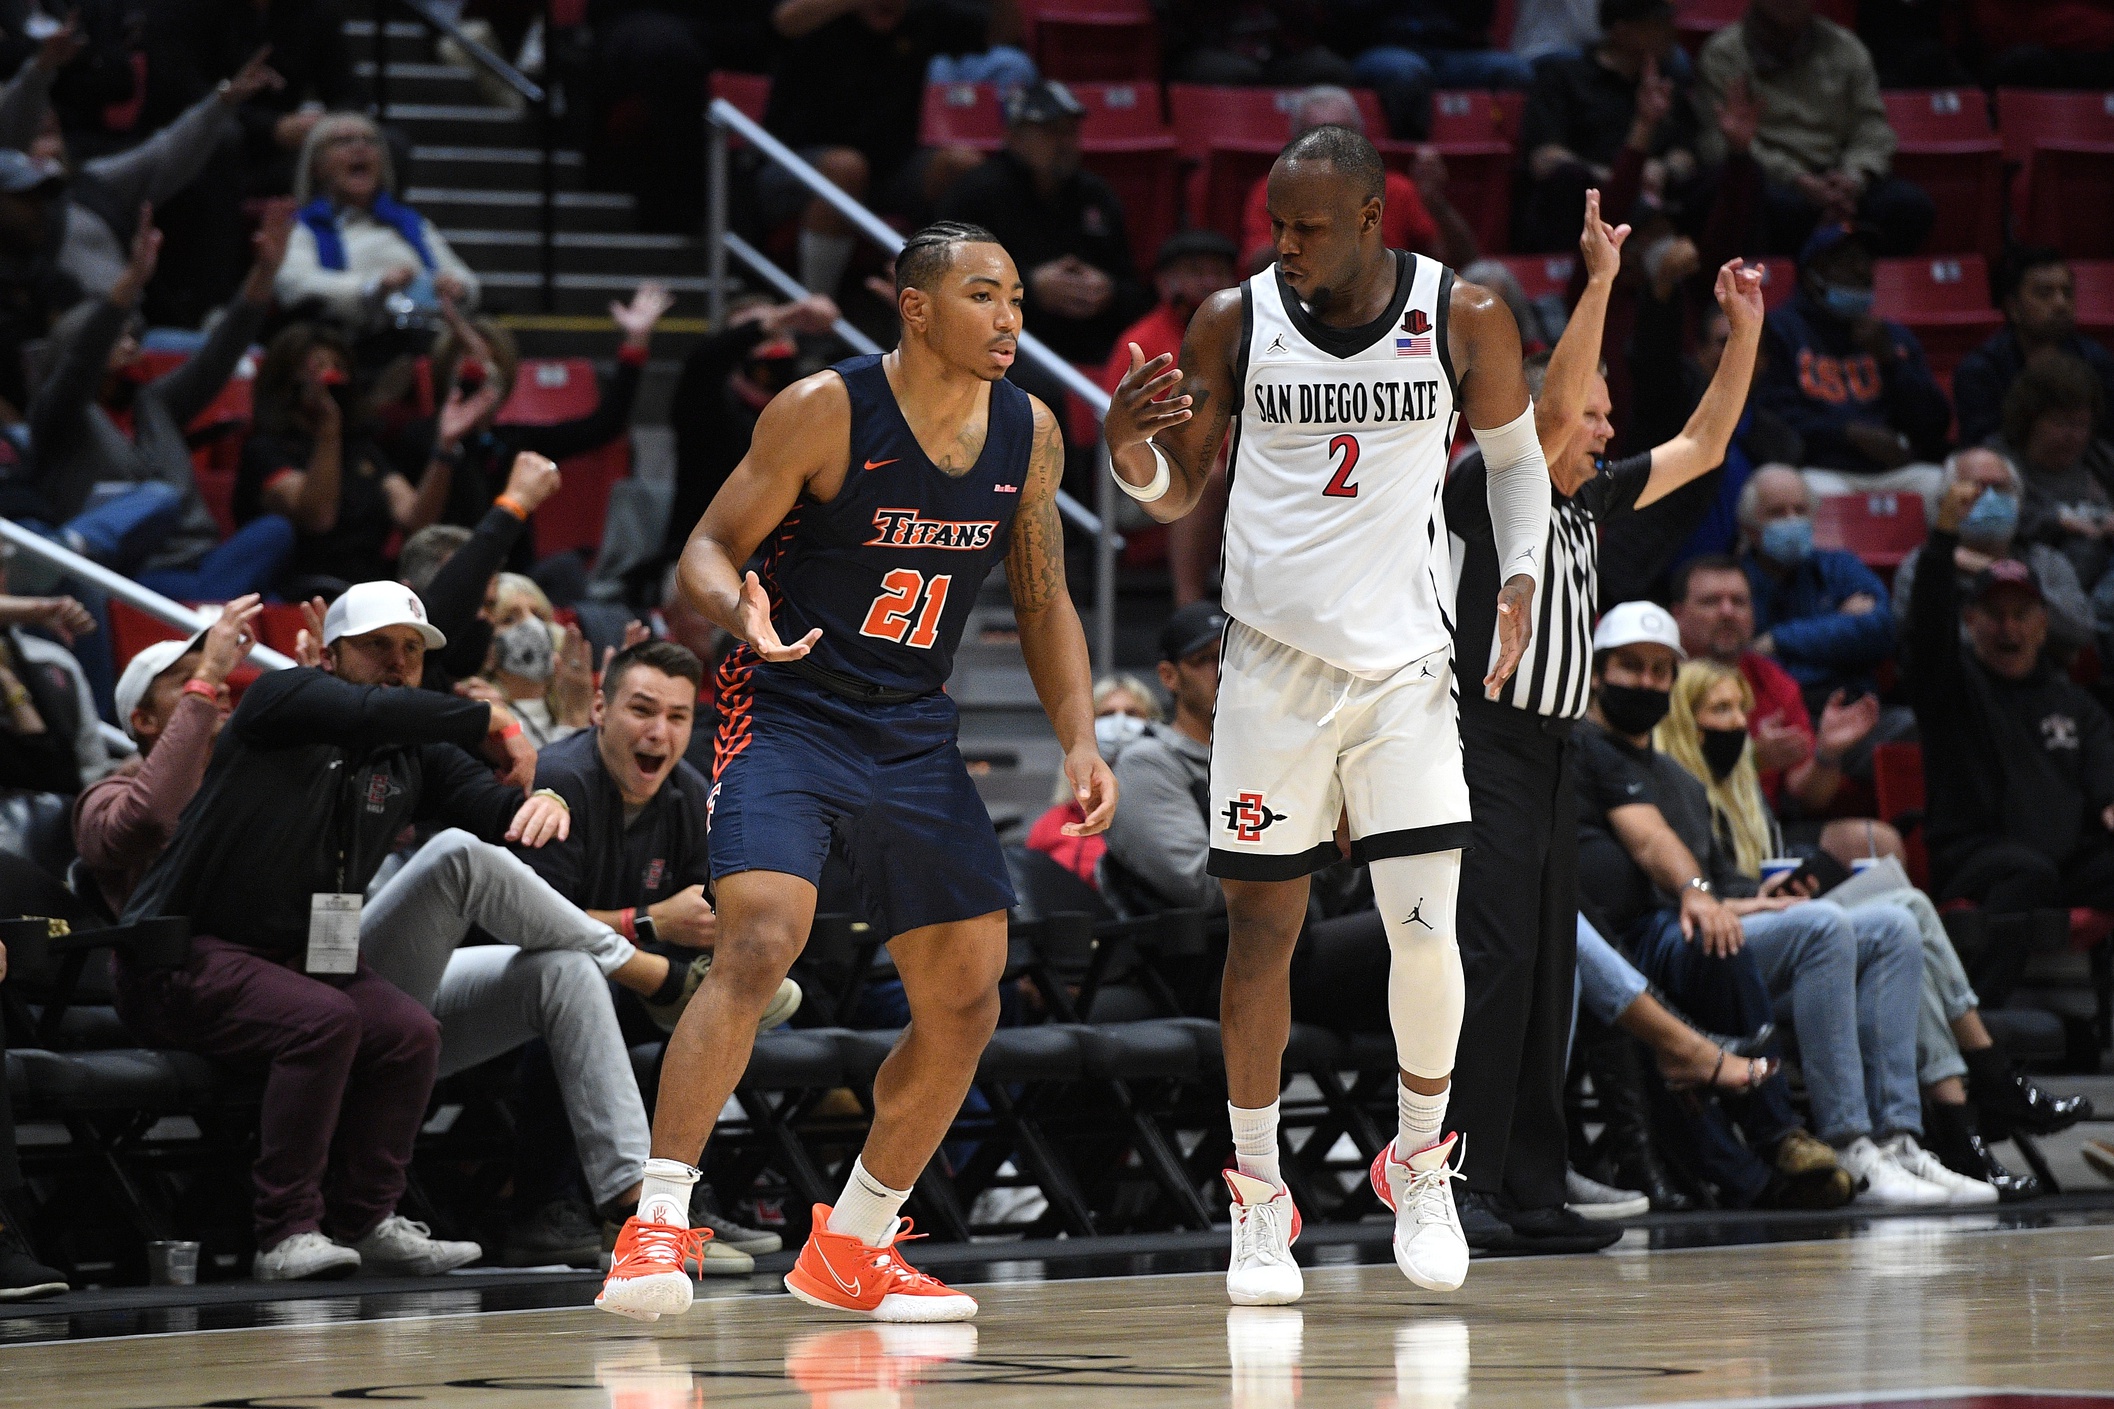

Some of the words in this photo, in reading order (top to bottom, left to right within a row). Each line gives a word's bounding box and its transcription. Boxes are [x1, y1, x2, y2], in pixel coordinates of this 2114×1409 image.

[1254, 384, 1292, 424] SAN
[1298, 382, 1368, 423] DIEGO
[1373, 380, 1439, 423] STATE
[1322, 433, 1361, 498] 2
[859, 568, 952, 649] 21
